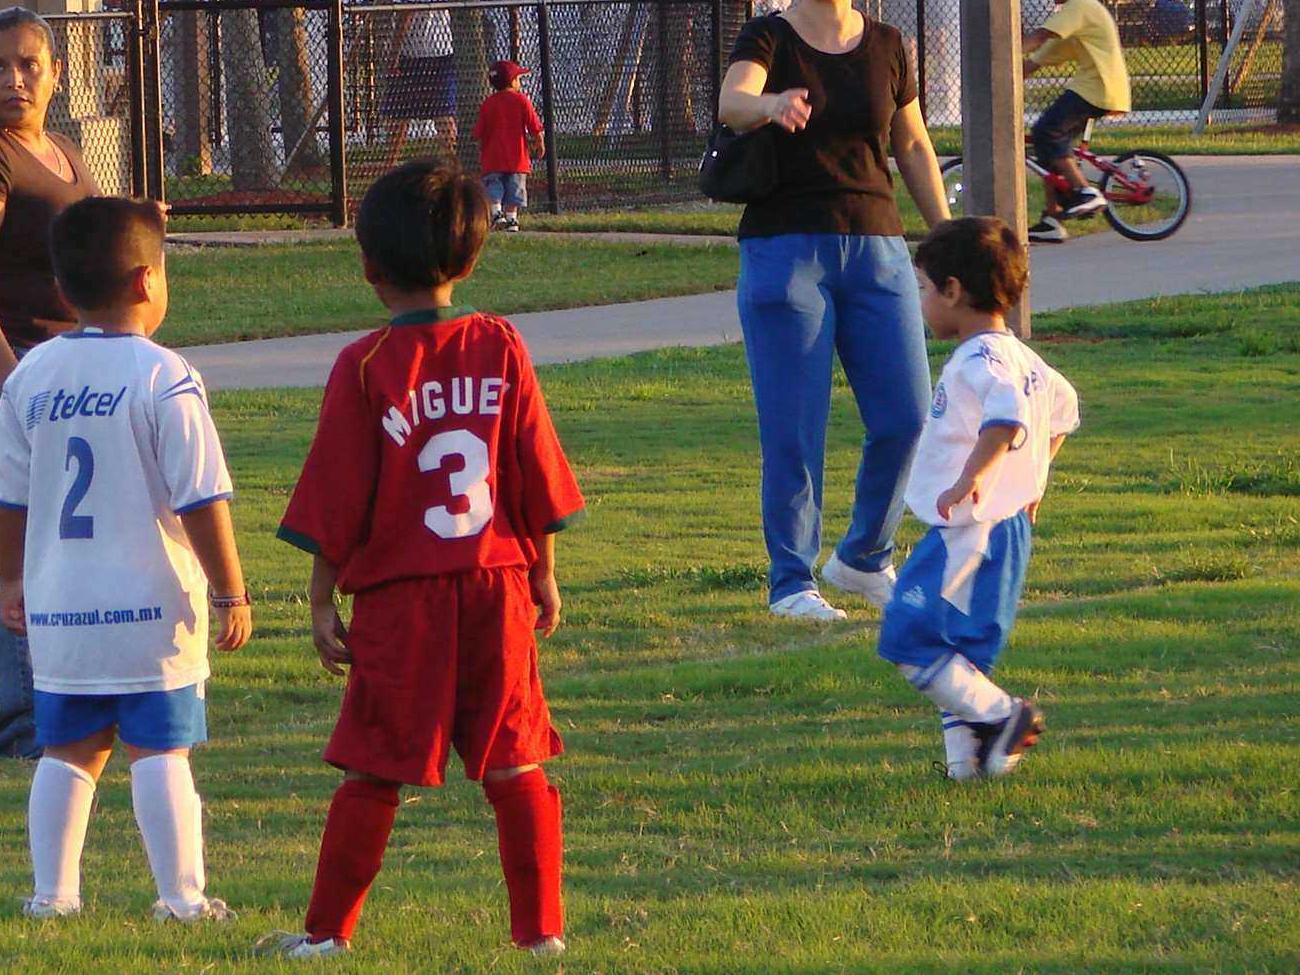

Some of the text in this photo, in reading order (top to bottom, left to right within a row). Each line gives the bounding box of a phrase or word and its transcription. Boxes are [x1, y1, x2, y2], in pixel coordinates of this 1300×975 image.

[49, 385, 127, 422] telcel
[381, 376, 511, 447] MIGUE
[59, 436, 95, 540] 2
[417, 428, 494, 539] 3
[29, 606, 163, 627] www.cruzazul.com.mx
